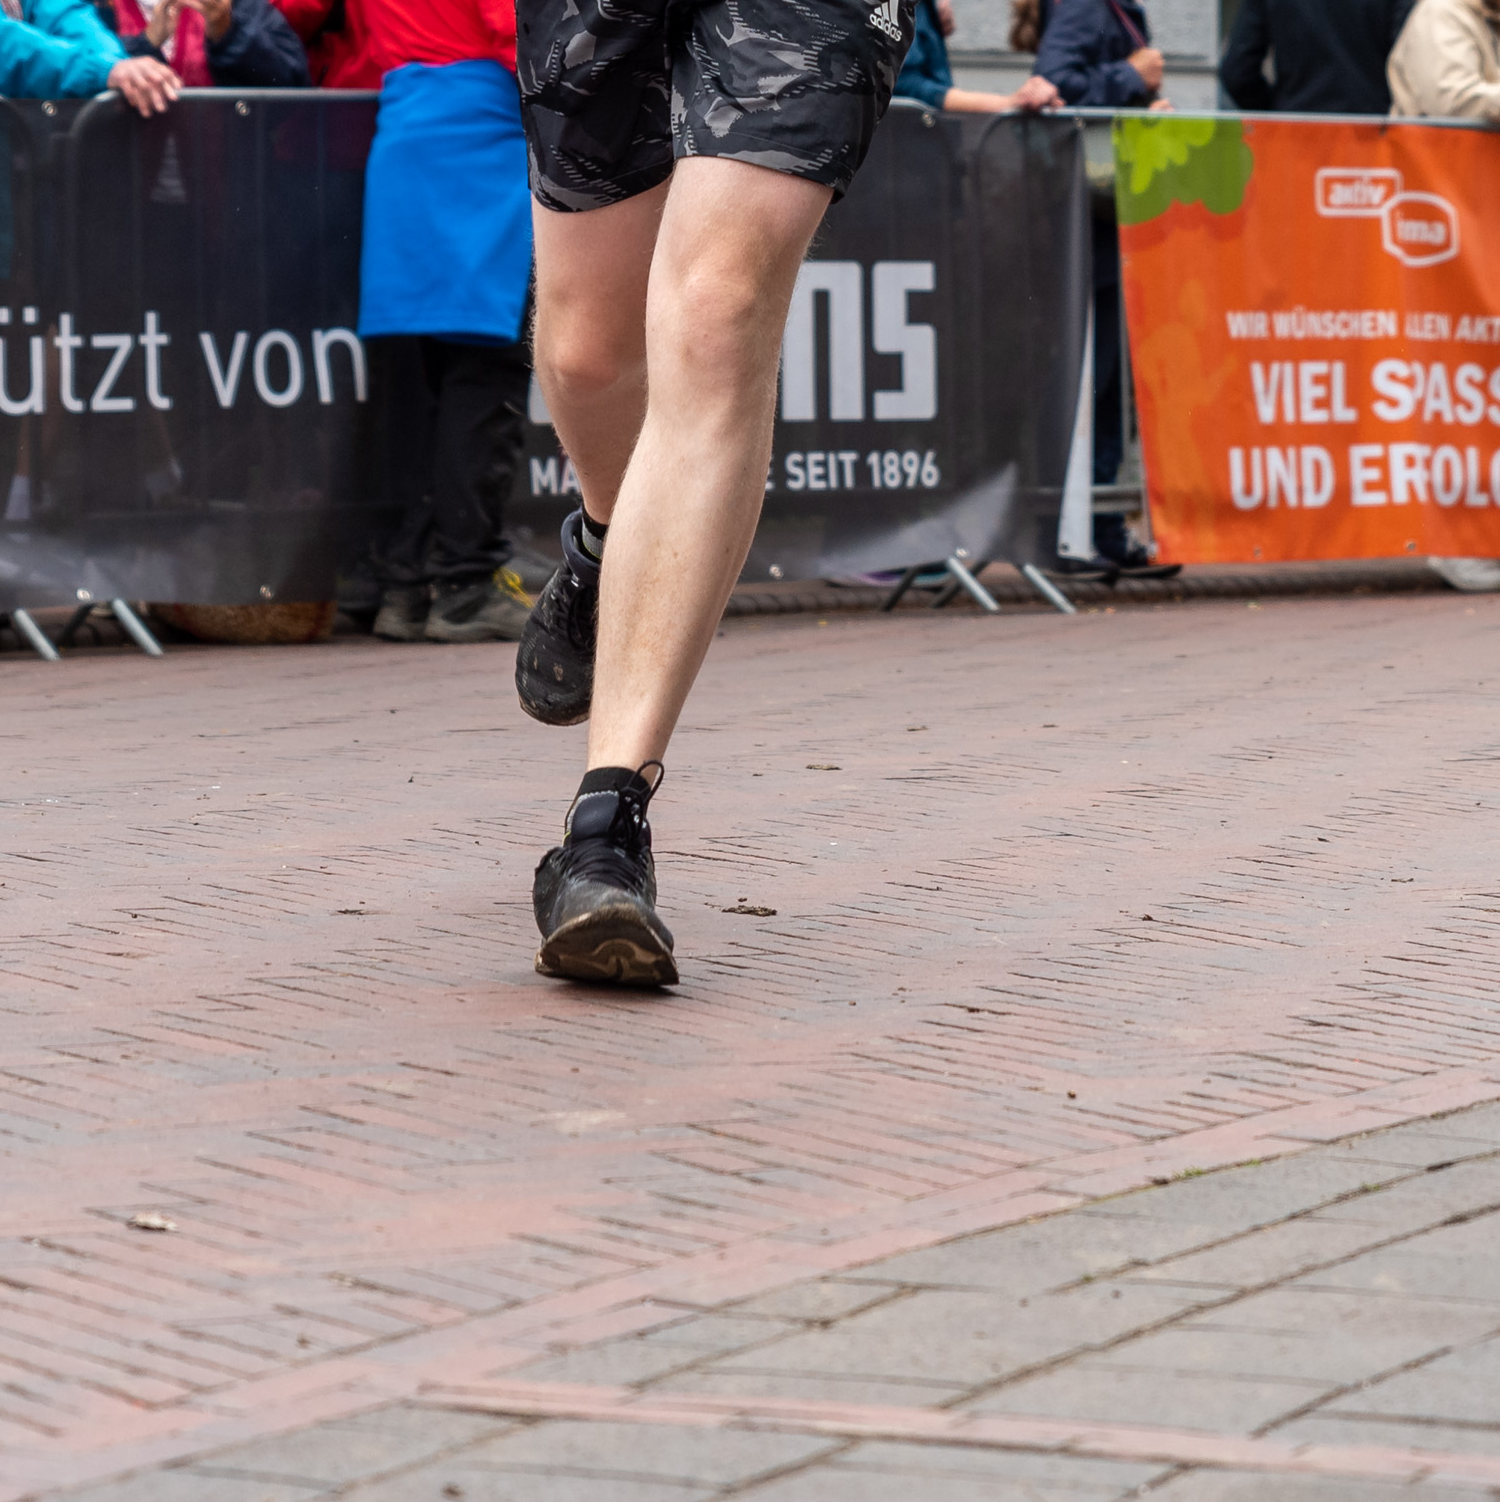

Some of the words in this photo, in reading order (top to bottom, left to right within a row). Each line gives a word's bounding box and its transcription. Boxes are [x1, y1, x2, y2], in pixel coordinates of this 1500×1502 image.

[869, 13, 902, 42] adidas
[1226, 310, 1270, 340] WIR
[1272, 305, 1398, 341] WÜNSCHEN
[198, 326, 368, 408] von
[1249, 360, 1359, 425] VIEL
[784, 451, 860, 490] SEIT
[866, 450, 940, 490] 1896
[1228, 446, 1336, 511] UND
